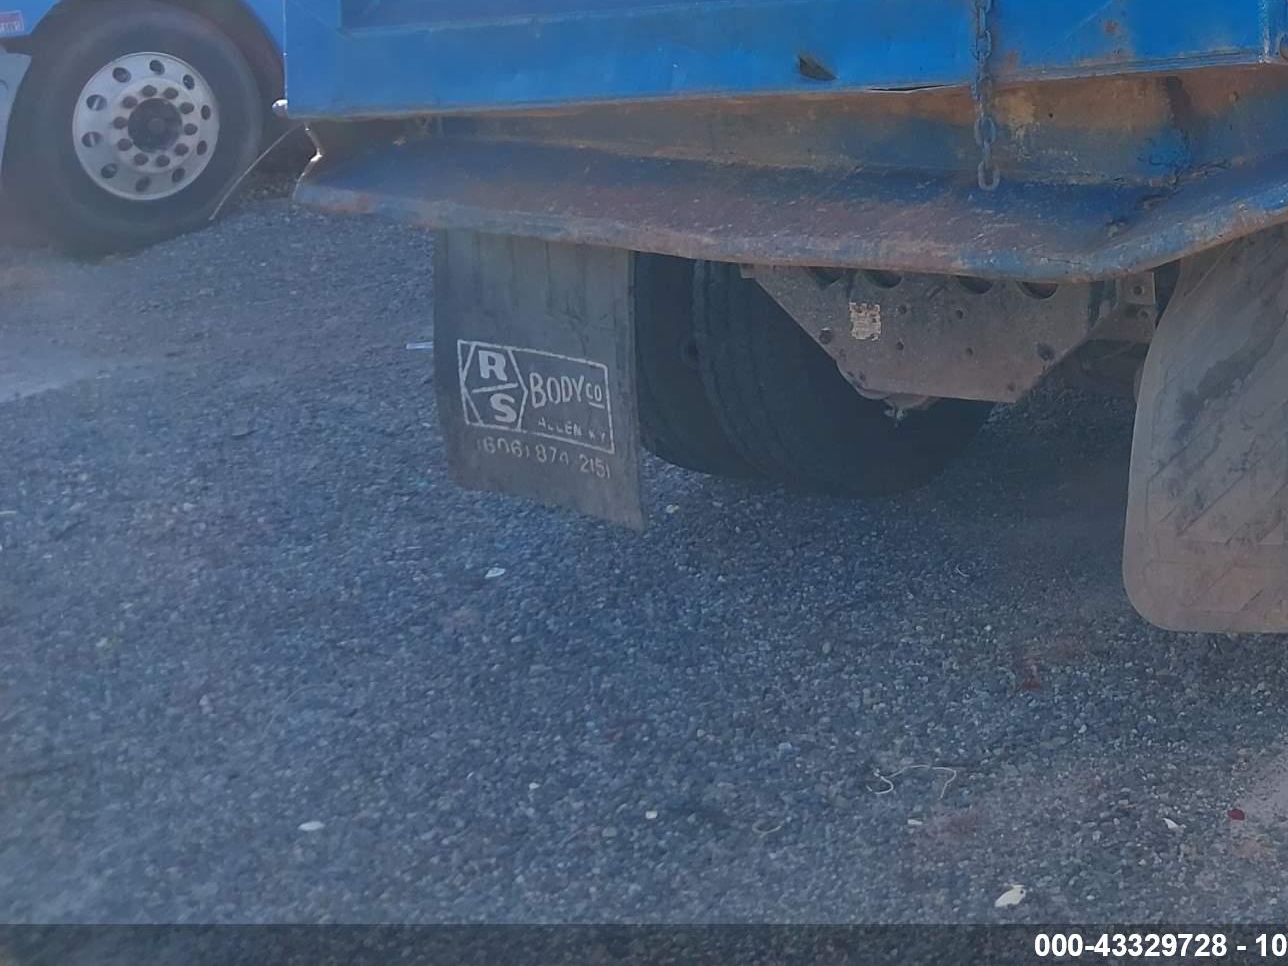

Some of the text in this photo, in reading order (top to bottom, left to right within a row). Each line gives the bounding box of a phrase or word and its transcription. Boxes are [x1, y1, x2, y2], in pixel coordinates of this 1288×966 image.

[478, 350, 508, 381] R
[529, 372, 585, 409] BODY
[490, 393, 517, 423] S
